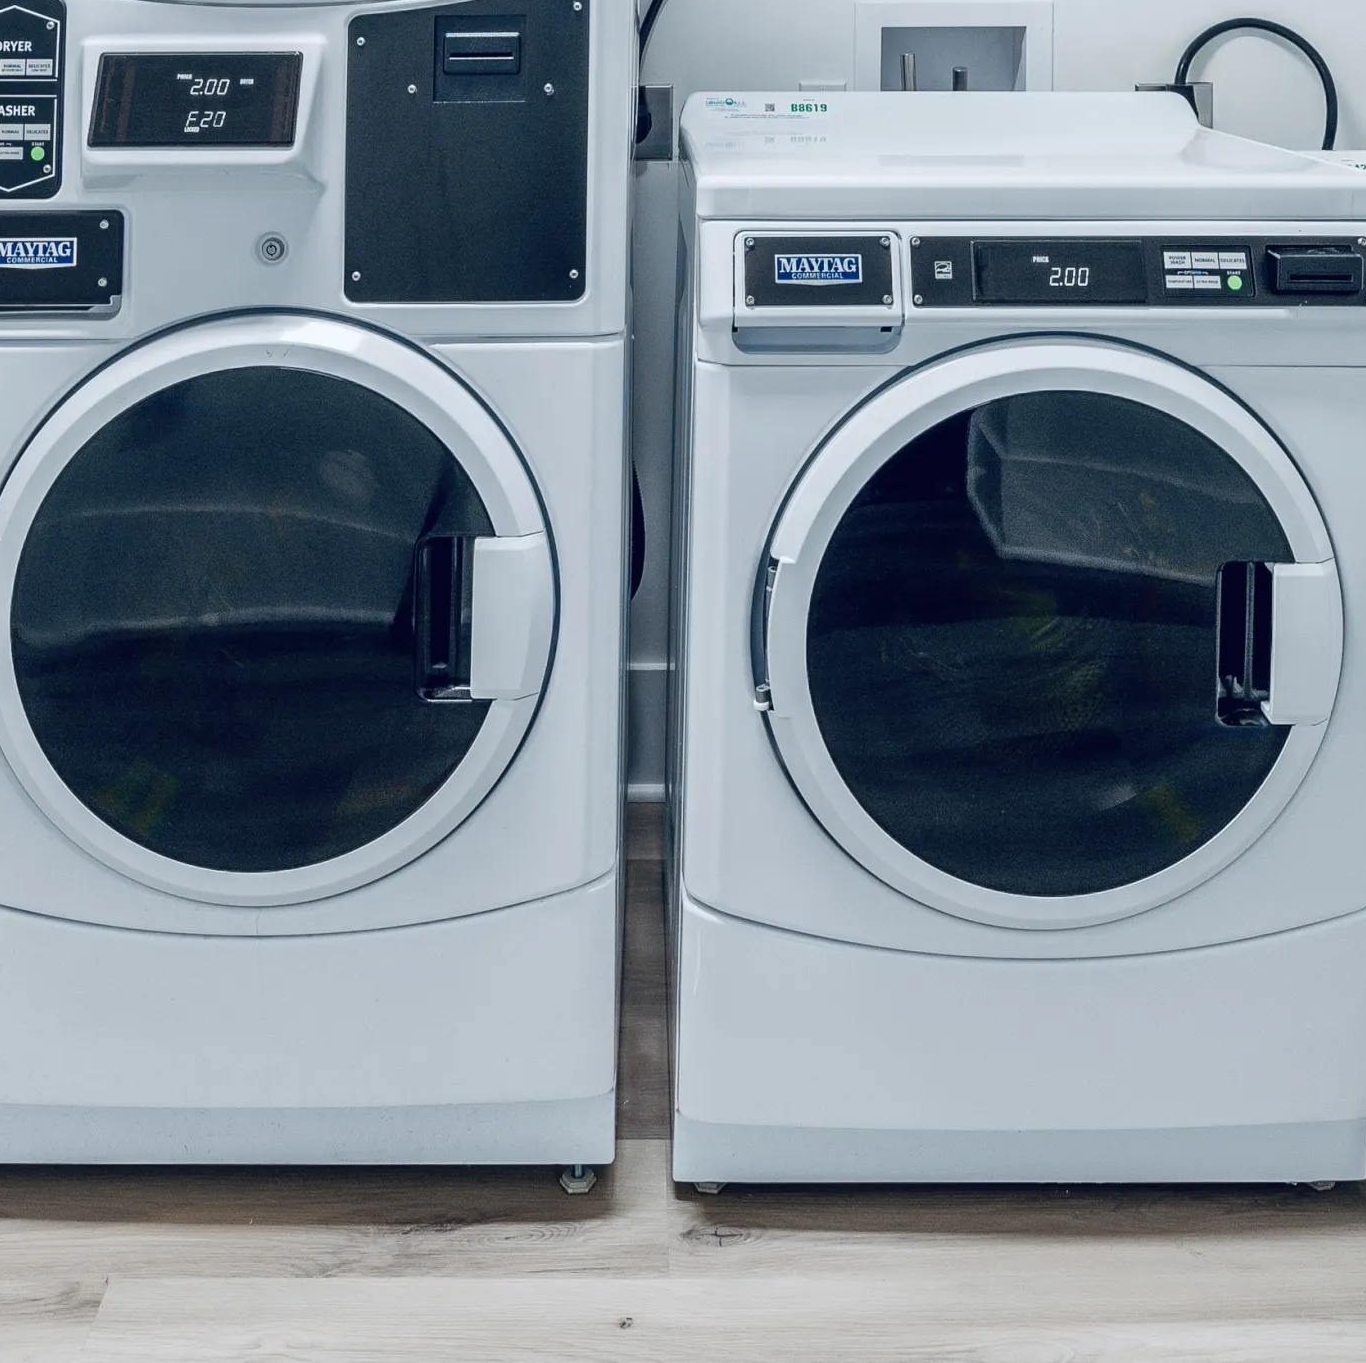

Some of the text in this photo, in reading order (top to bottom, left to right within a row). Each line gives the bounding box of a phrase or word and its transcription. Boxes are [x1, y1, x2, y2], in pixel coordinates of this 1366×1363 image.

[190, 78, 230, 95] 2.00
[791, 103, 828, 112] B8619
[778, 257, 857, 273] MAYTAG
[1049, 267, 1089, 286] 2.00
